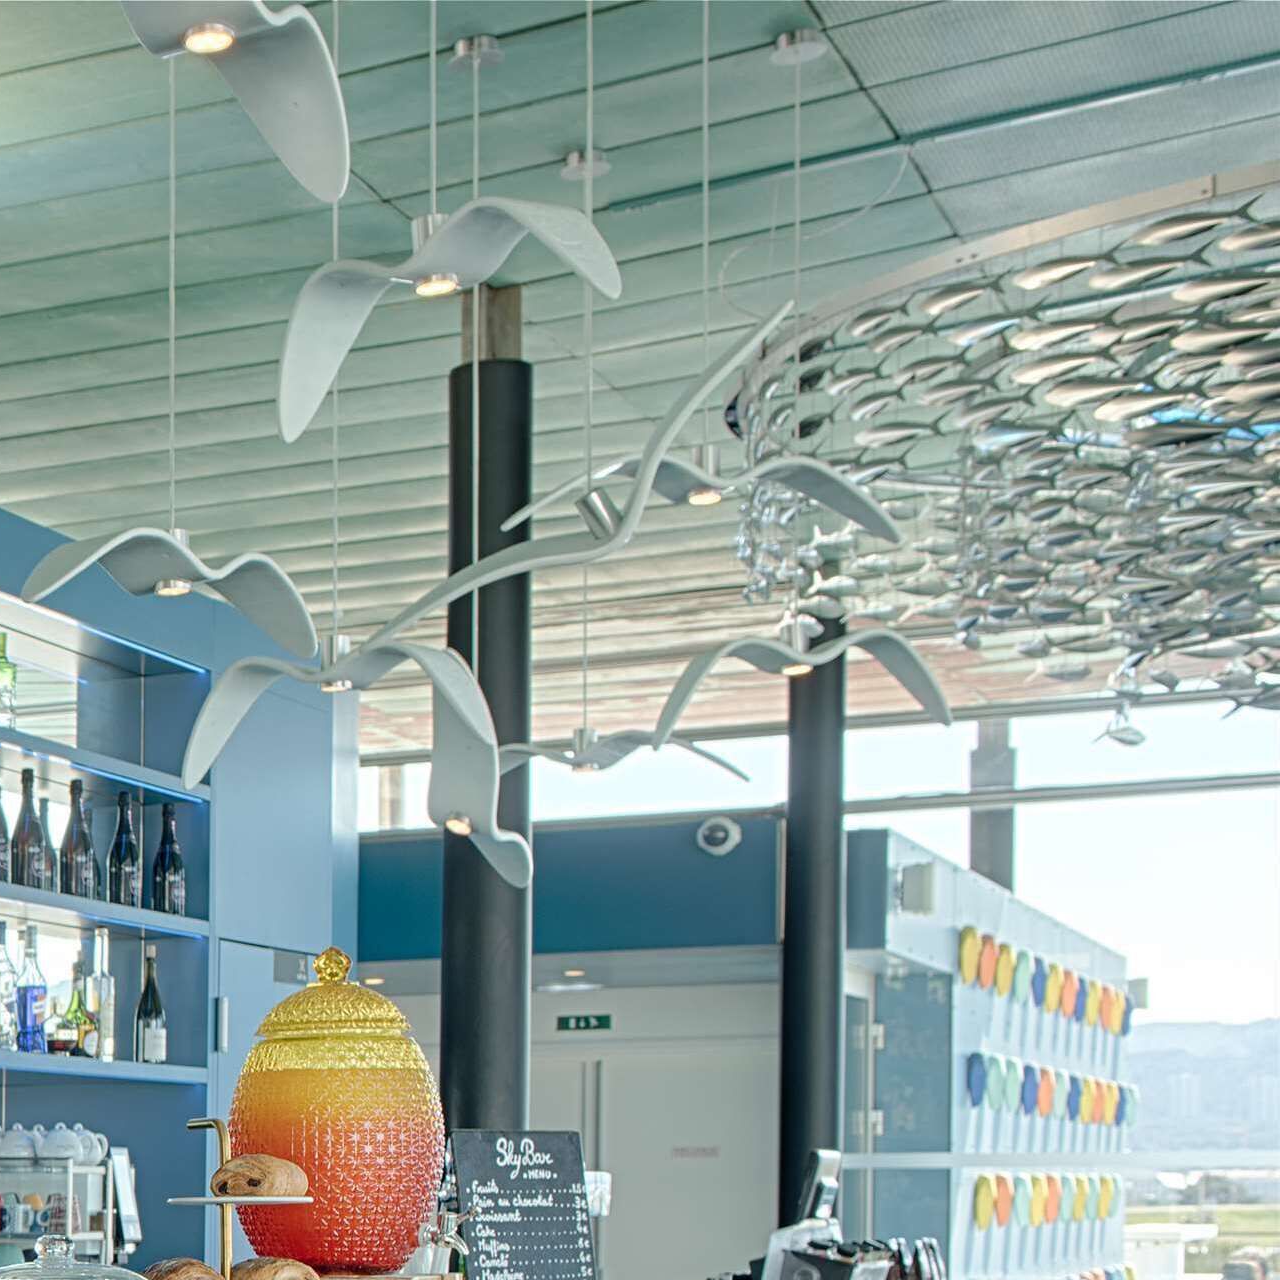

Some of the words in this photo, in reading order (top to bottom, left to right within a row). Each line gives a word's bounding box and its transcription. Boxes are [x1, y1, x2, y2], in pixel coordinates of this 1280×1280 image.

[528, 1169, 552, 1179] MENU
[472, 1179, 499, 1194] Fruits
[472, 1196, 495, 1208] Pain
[498, 1198, 511, 1208] au
[512, 1194, 554, 1208] chocolat
[475, 1224, 496, 1238] Cake
[478, 1238, 510, 1257] Muffins
